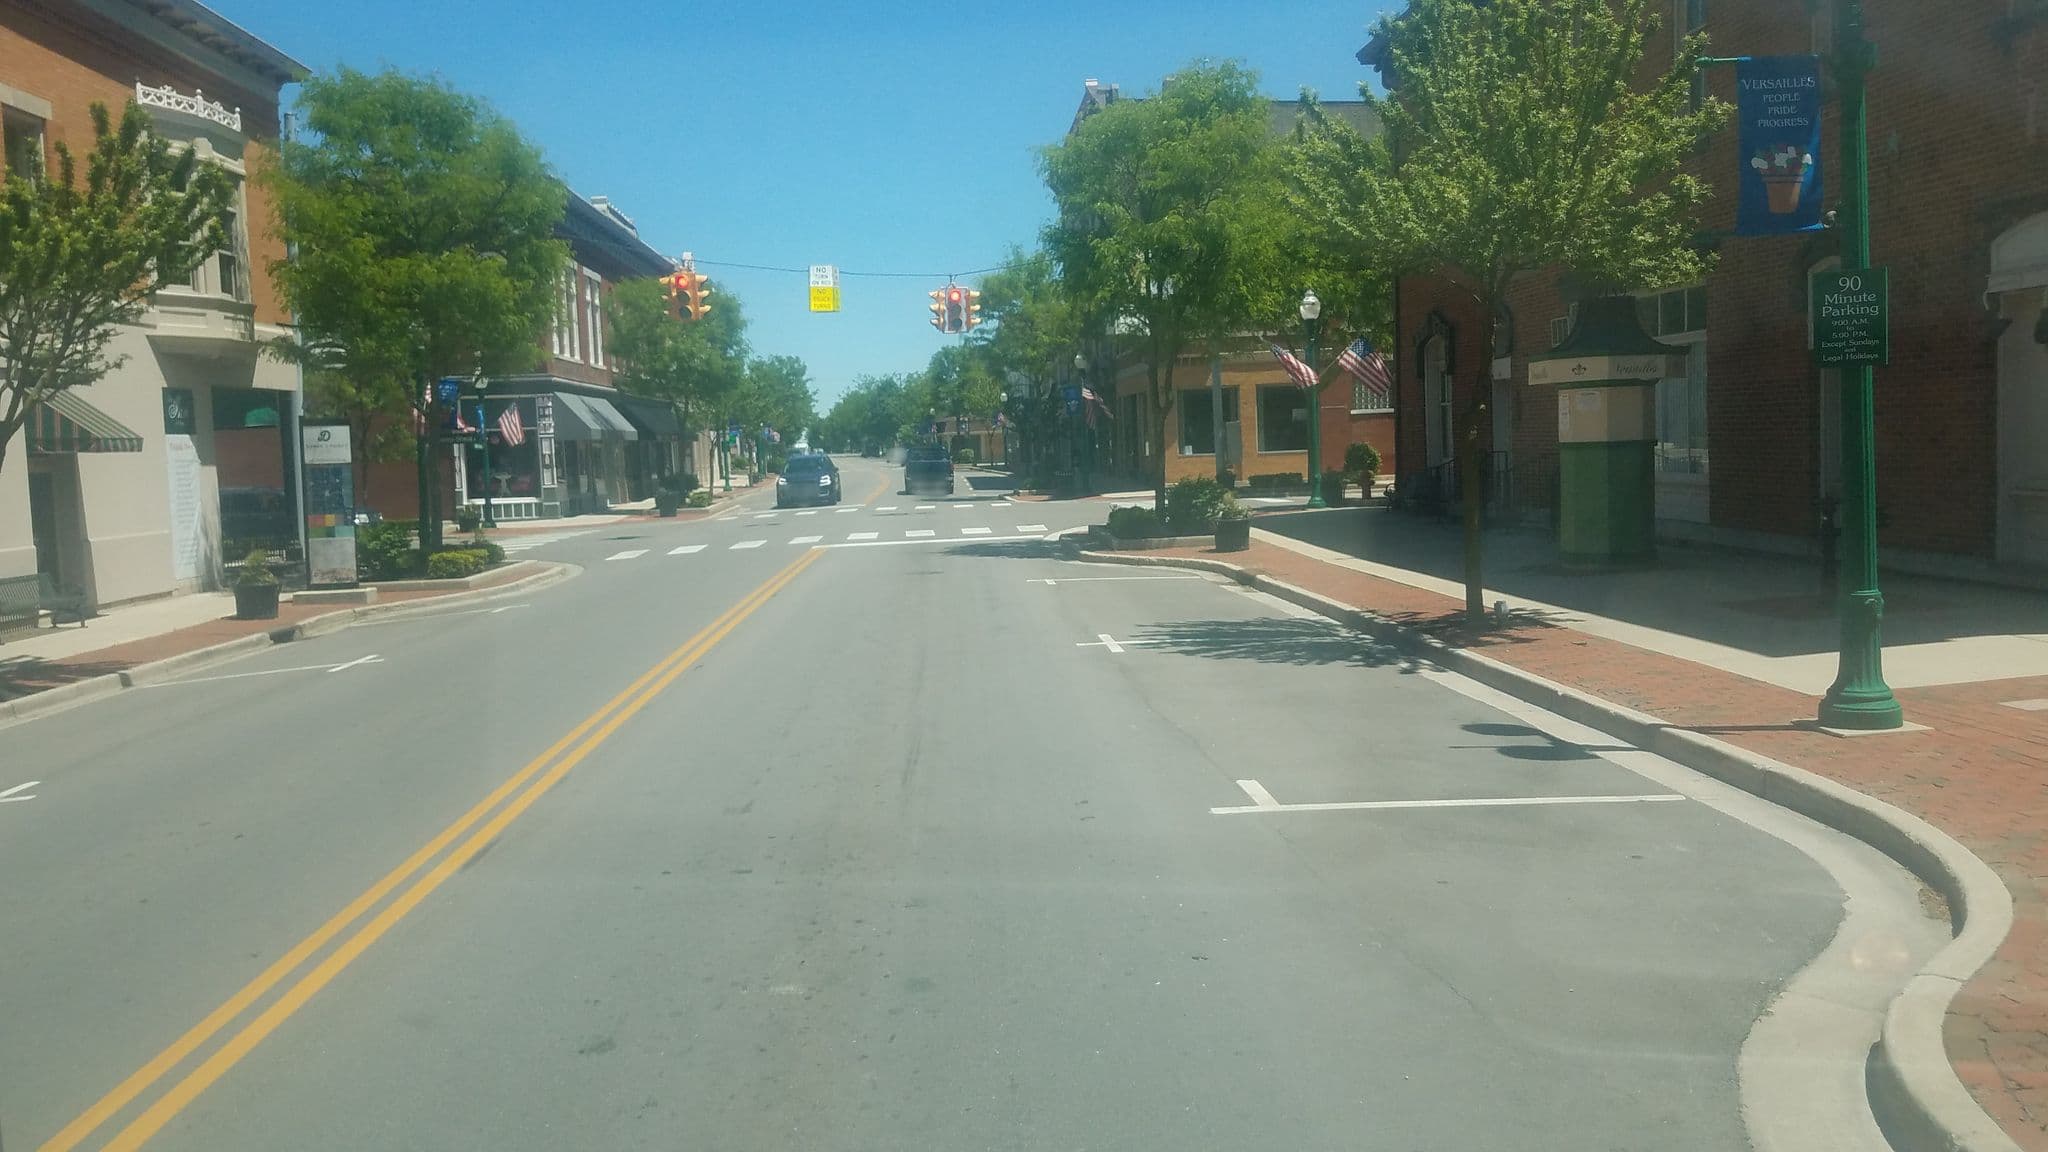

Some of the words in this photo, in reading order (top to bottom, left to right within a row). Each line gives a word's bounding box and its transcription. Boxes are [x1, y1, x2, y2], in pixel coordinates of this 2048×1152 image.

[1763, 92, 1800, 103] PEOPLE
[1768, 105, 1798, 116] PRIDE
[1758, 117, 1809, 128] PROGRESS
[1838, 275, 1862, 292] 90
[1824, 292, 1878, 305] Minute
[1822, 304, 1880, 317] Parking
[1821, 340, 1846, 348] Except
[1849, 338, 1880, 346] Sundays
[1822, 354, 1843, 362] Legal
[1846, 352, 1879, 360] Holidays
